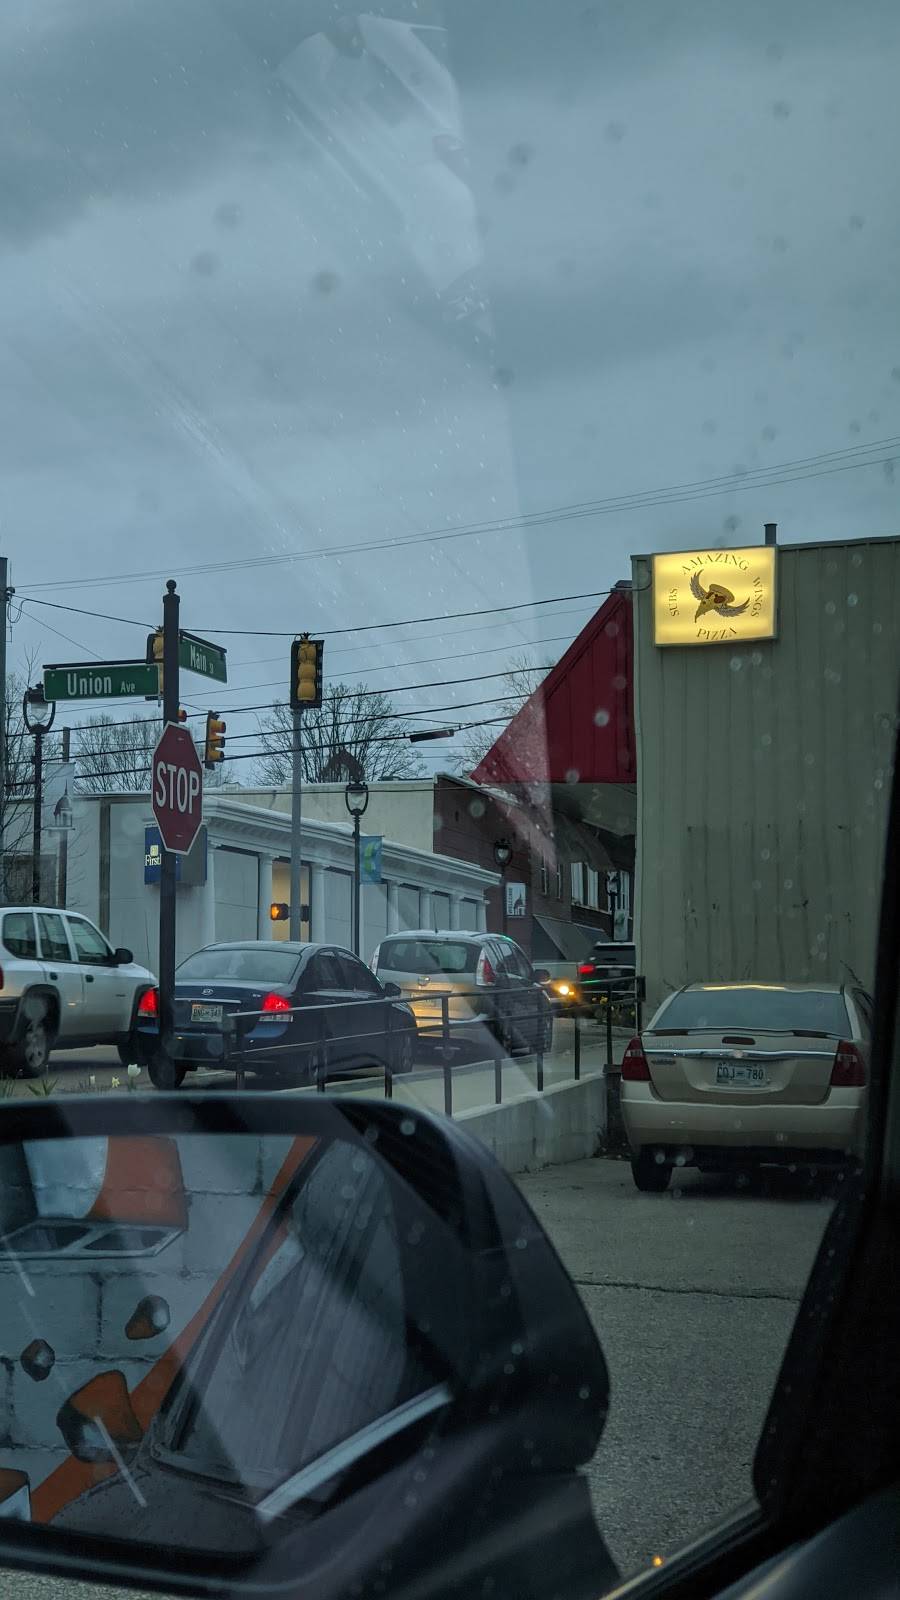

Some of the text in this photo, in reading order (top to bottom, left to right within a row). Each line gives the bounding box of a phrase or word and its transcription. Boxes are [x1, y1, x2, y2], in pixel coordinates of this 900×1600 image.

[682, 552, 749, 575] AMAZING
[668, 588, 680, 617] SUBS
[751, 576, 763, 617] WINGS
[696, 627, 737, 640] PIZZA
[190, 644, 207, 673] Main
[67, 671, 136, 696] Union Ave
[155, 760, 200, 814] STOP
